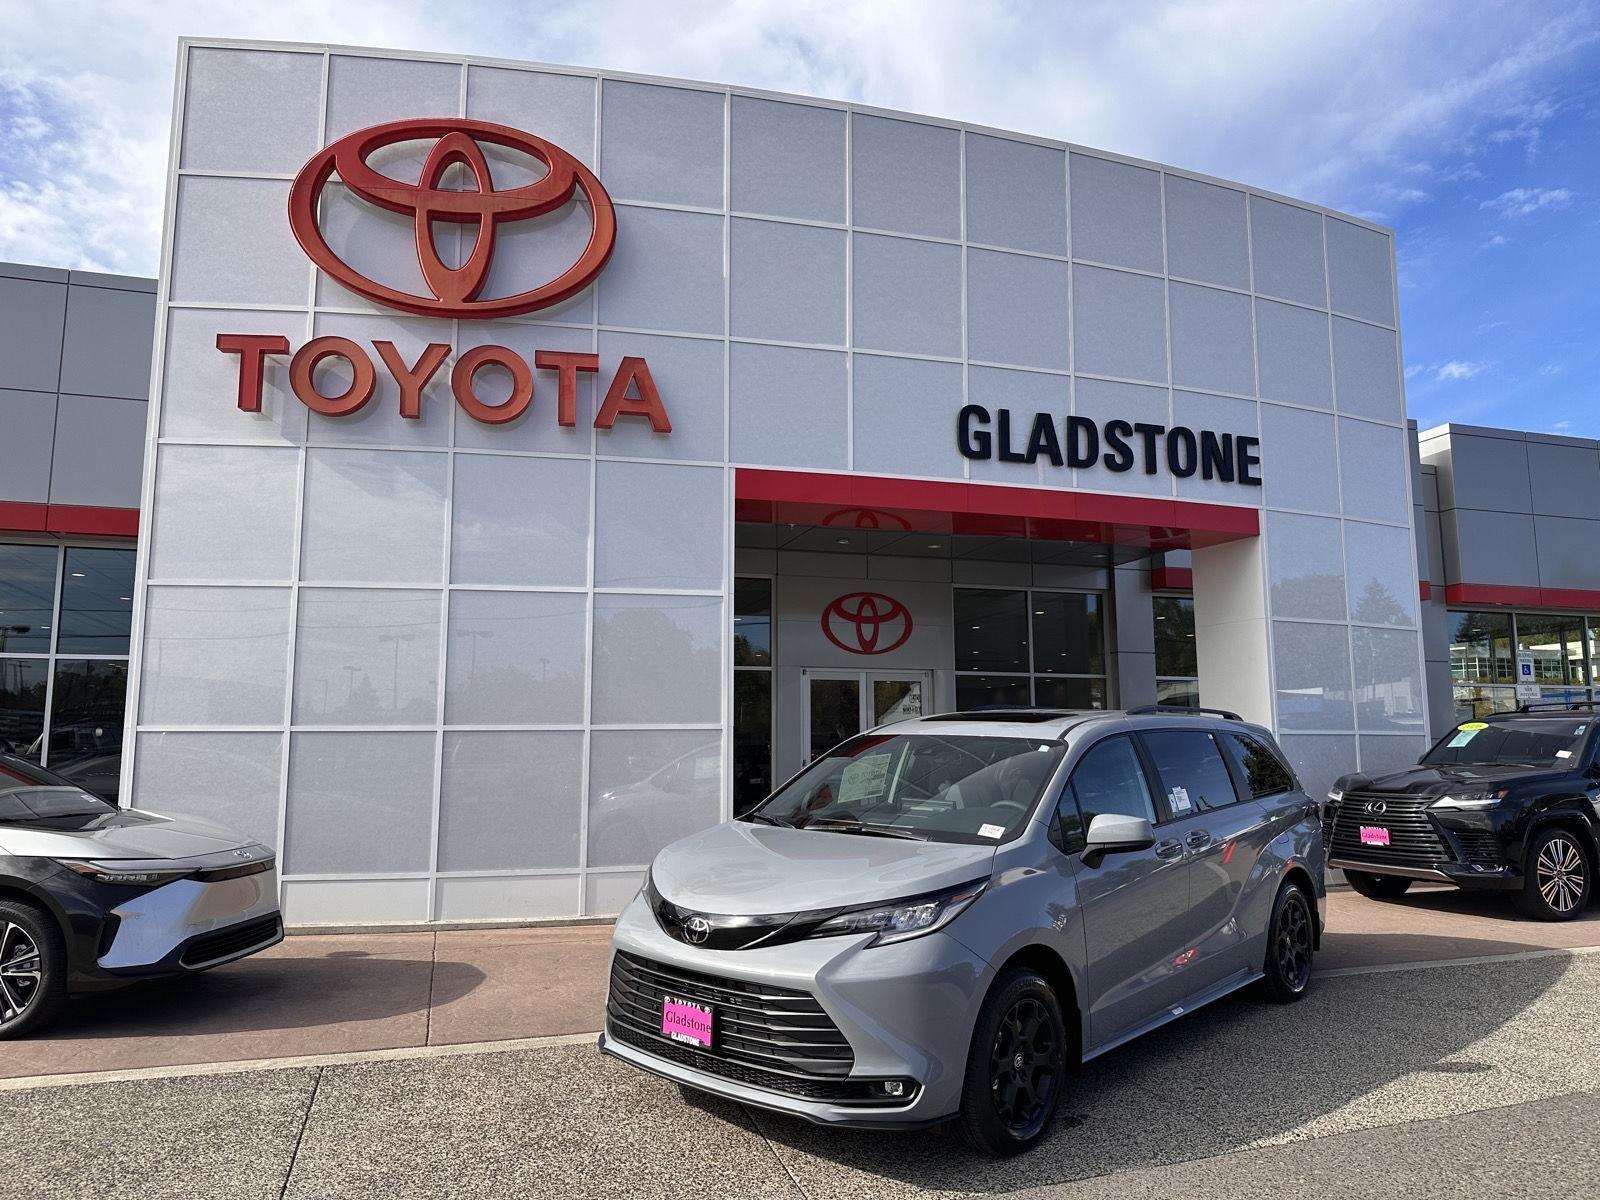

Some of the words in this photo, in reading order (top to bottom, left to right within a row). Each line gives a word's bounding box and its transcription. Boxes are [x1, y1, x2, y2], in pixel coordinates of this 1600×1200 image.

[216, 333, 673, 433] TOYOTA
[957, 404, 1262, 486] GLADSTONE
[673, 998, 701, 1010] TOYOTA
[665, 1010, 711, 1034] Gladstone
[671, 1032, 700, 1046] GLADSTONE
